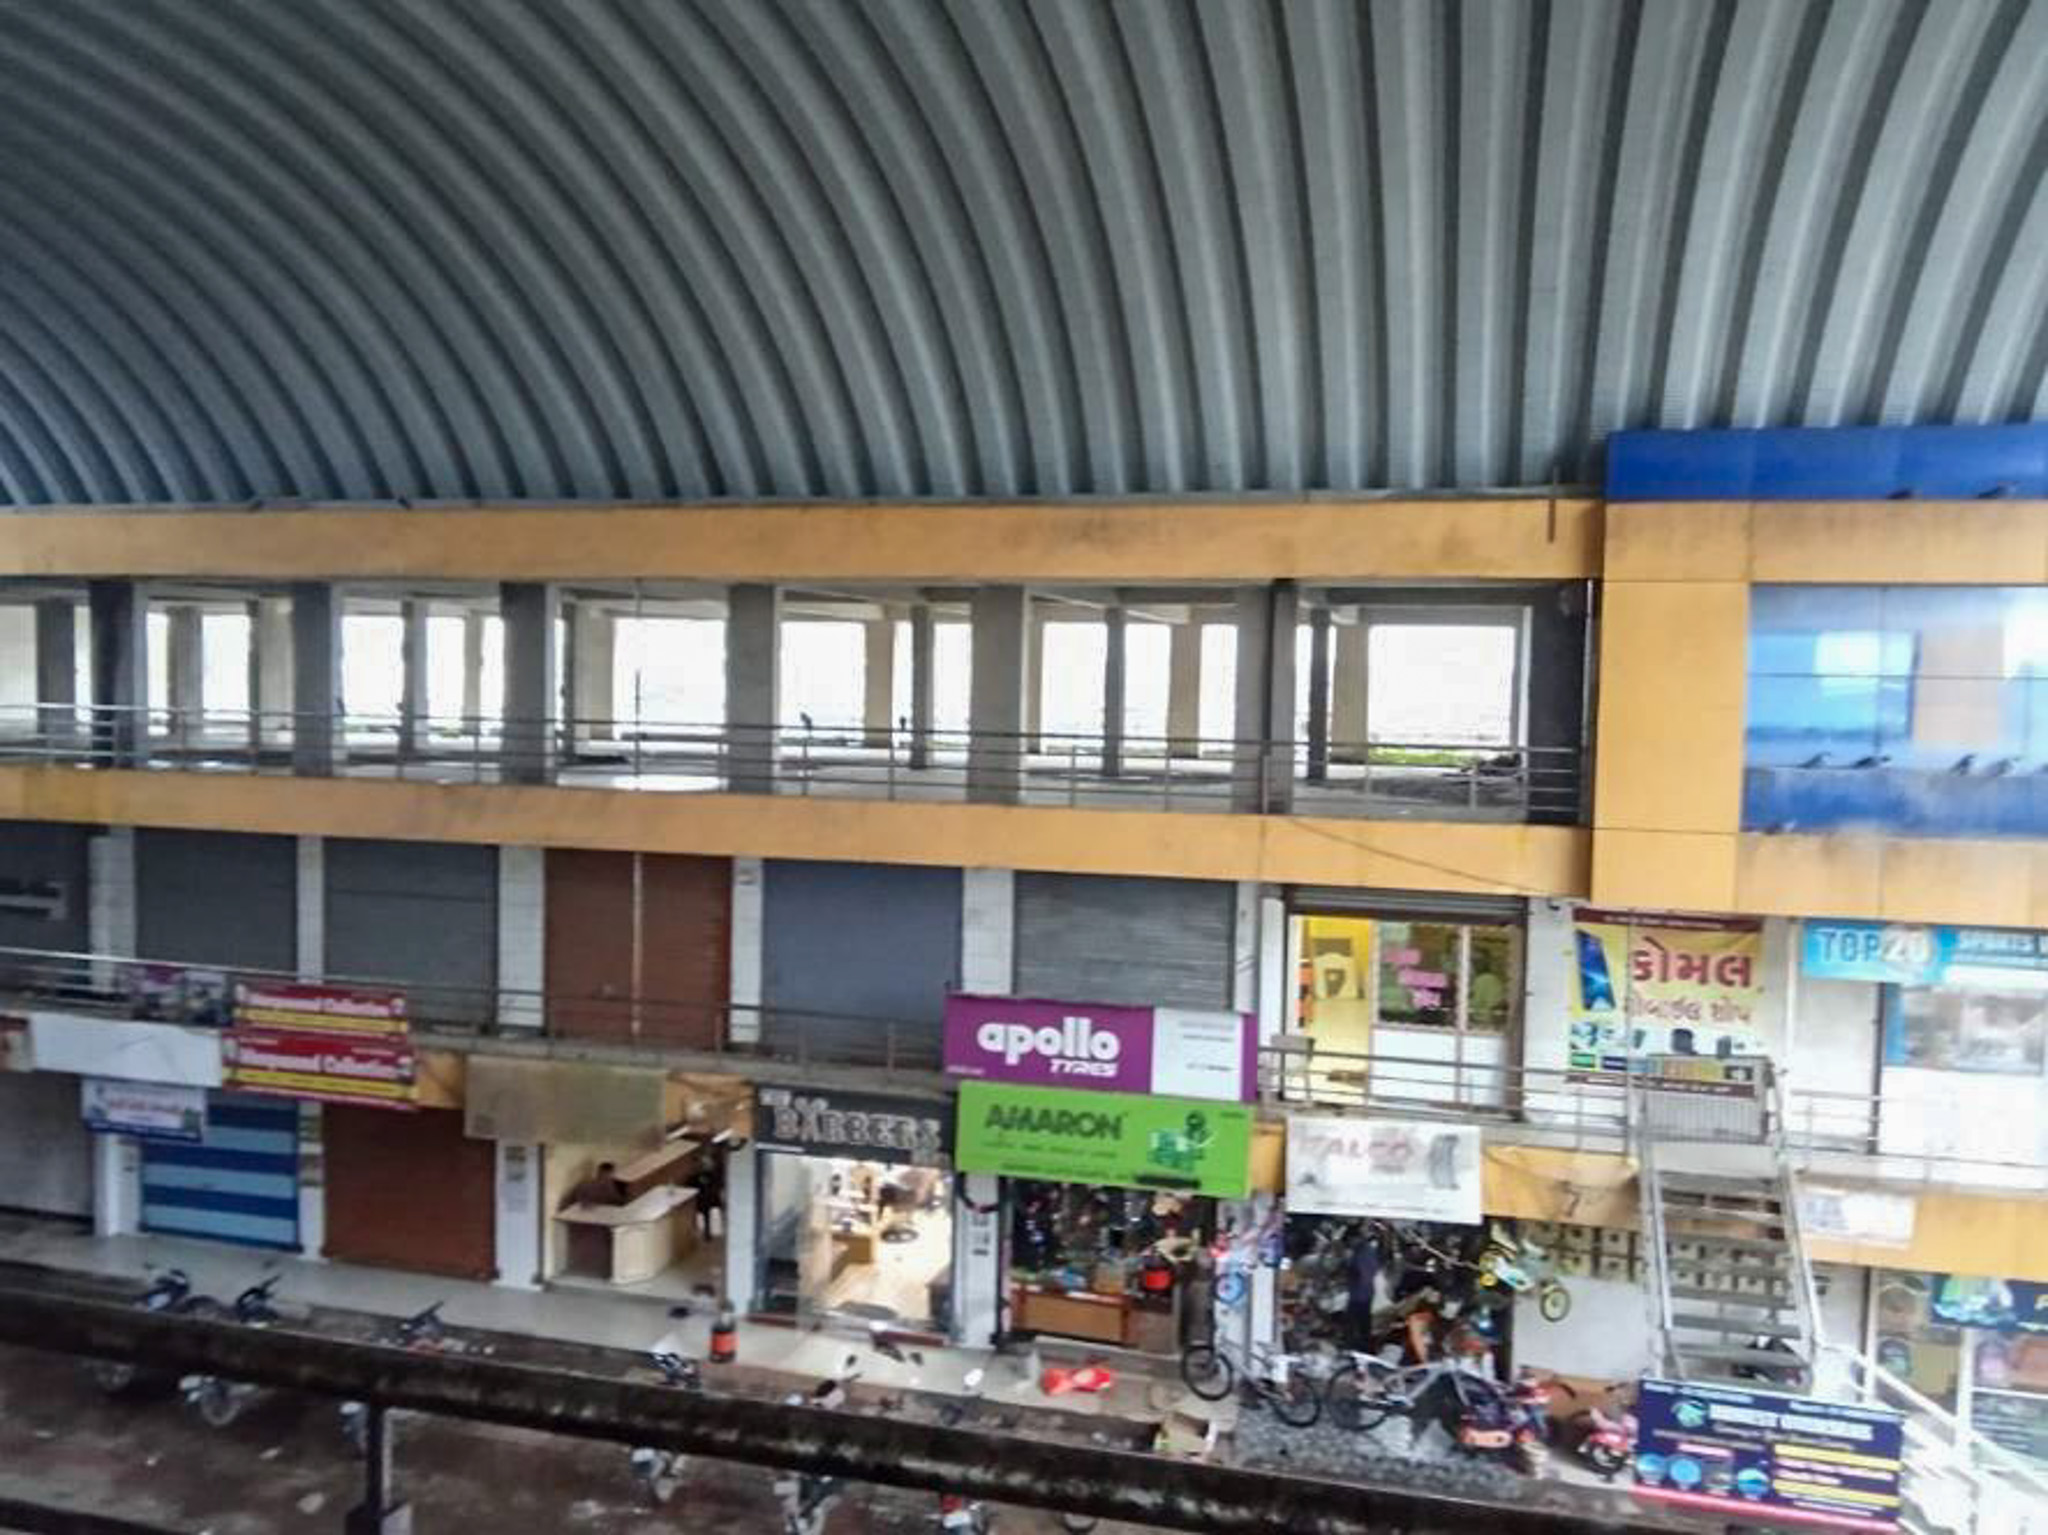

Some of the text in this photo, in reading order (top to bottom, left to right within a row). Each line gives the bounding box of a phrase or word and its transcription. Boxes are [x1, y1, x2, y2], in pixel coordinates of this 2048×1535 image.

[1632, 935, 1752, 987] કોમલ
[977, 1016, 1119, 1066] apollo
[1050, 1058, 1118, 1078] TYRES
[985, 1104, 1122, 1140] AMARON
